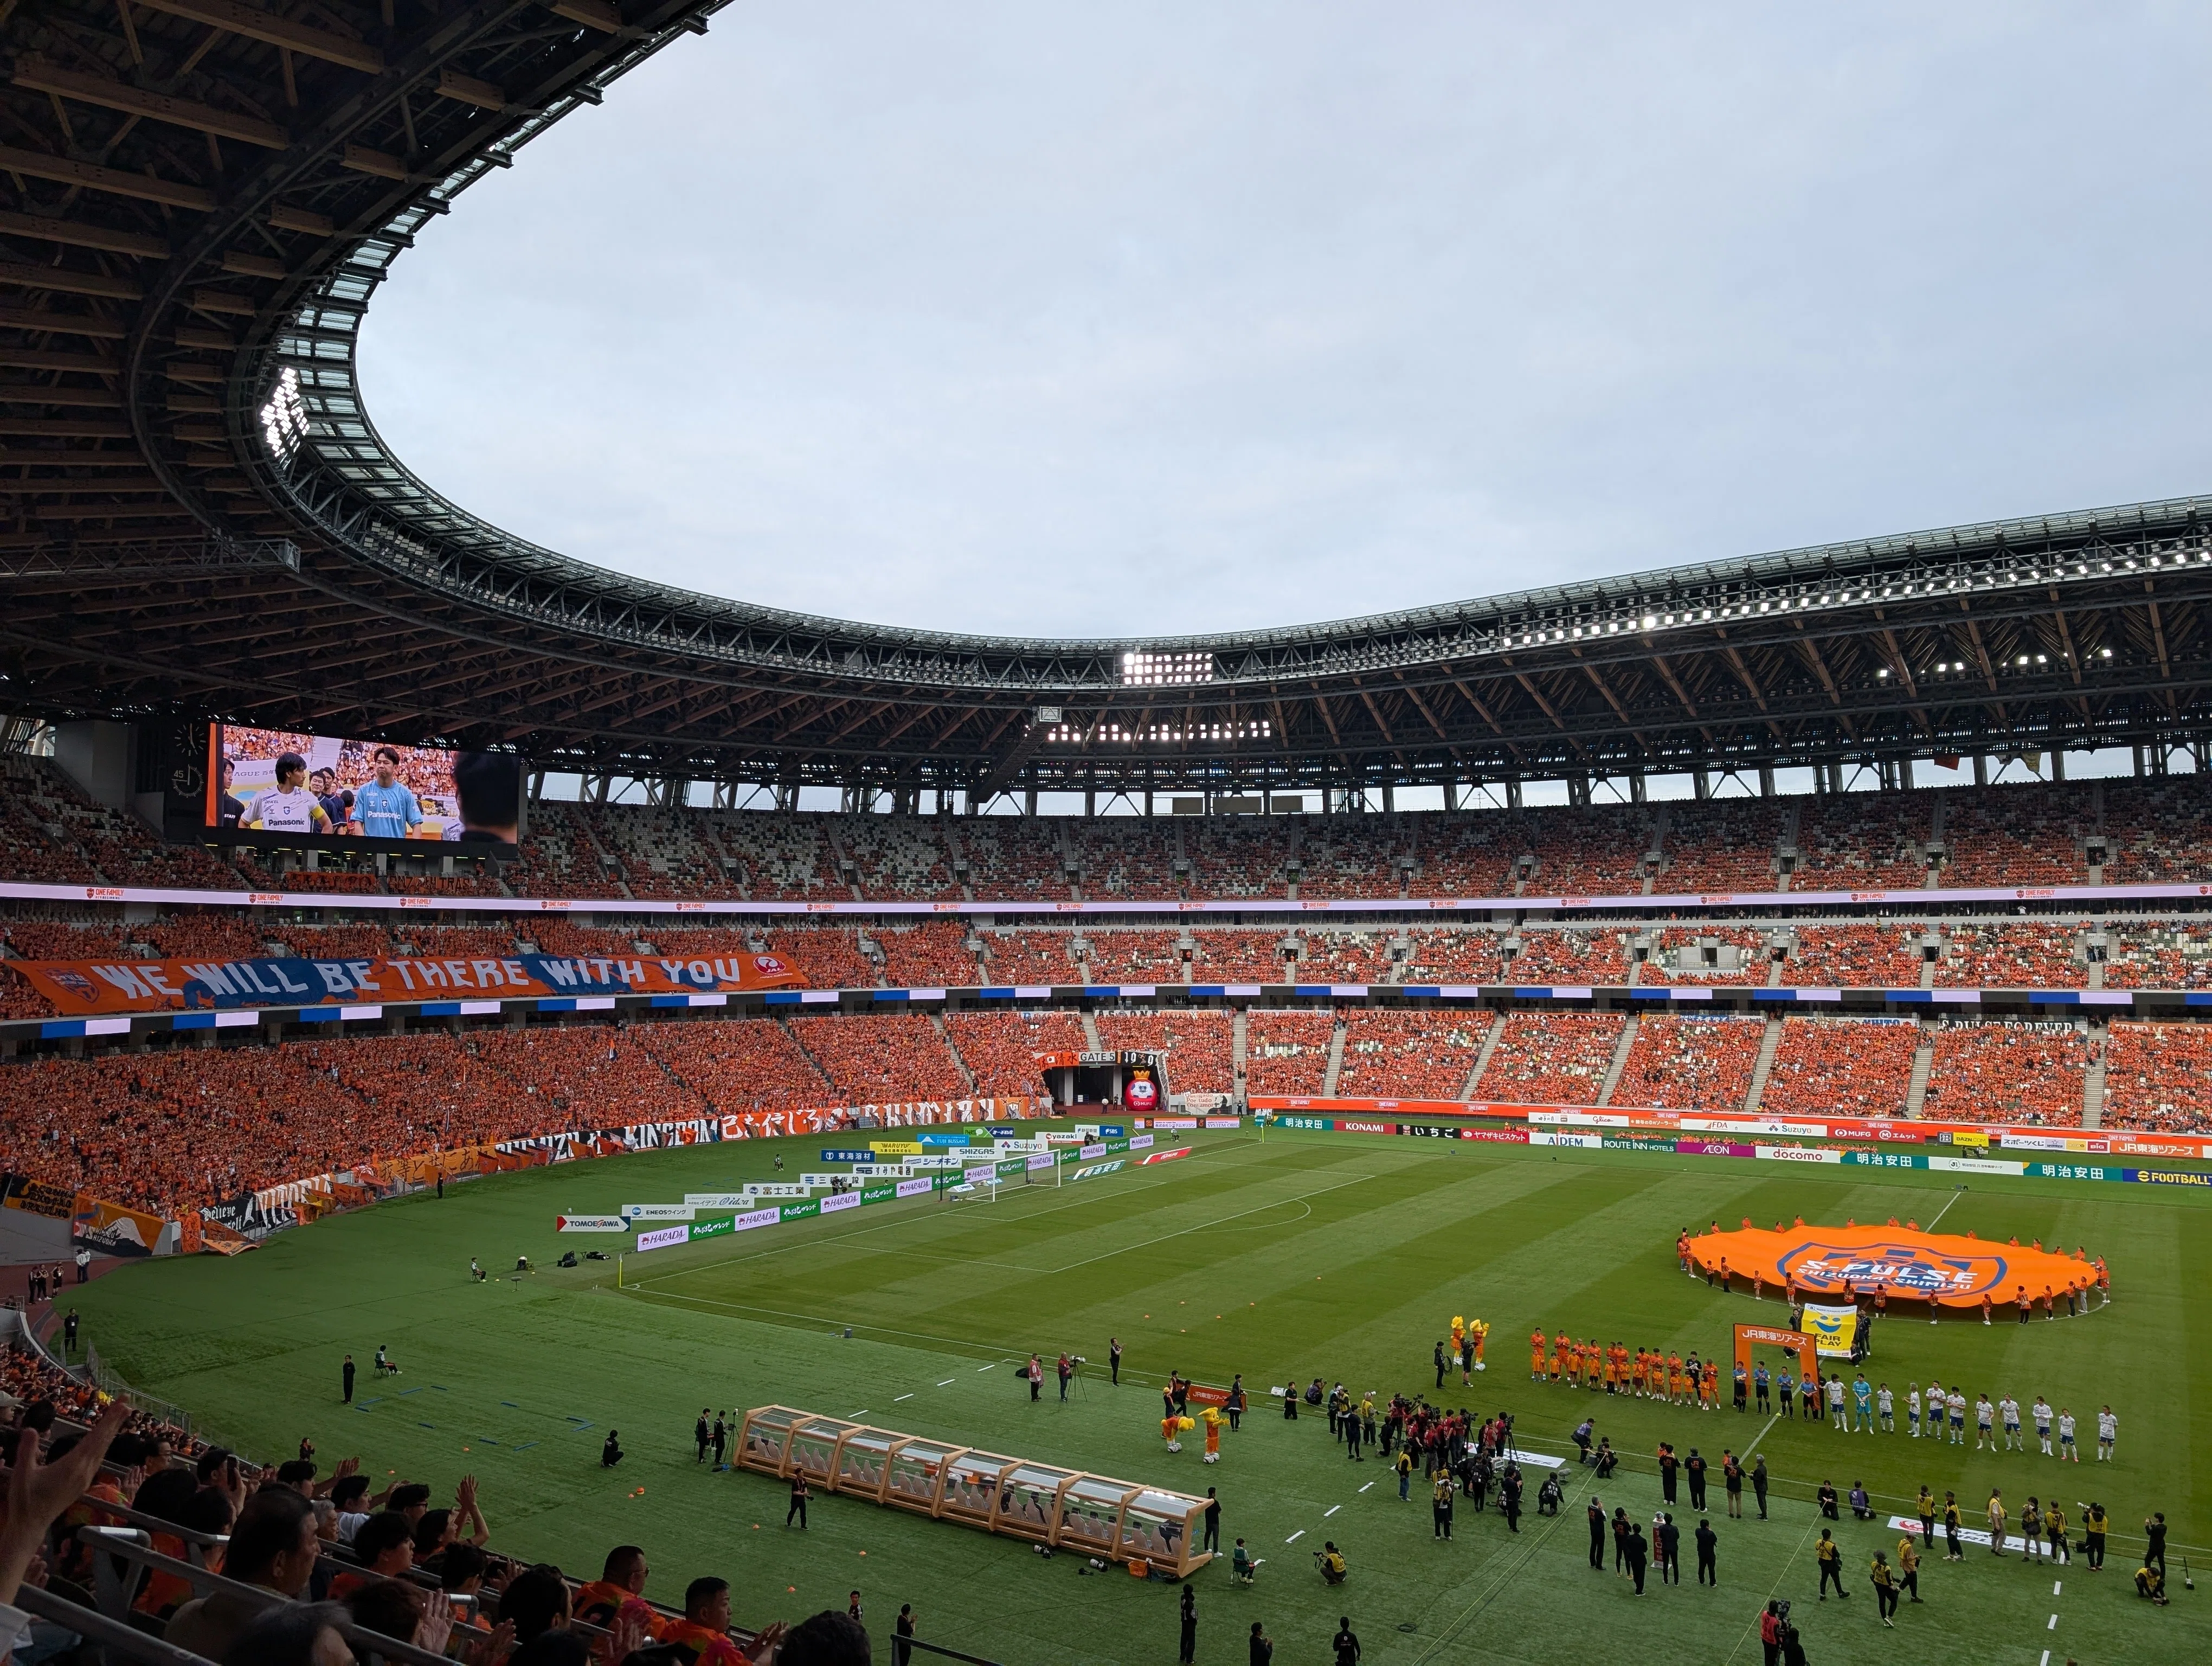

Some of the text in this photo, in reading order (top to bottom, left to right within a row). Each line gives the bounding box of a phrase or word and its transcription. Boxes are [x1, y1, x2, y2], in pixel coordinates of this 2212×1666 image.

[368, 811, 401, 819] Panasonic
[91, 958, 740, 999] WE WILL BE THERE WITH YOU
[1081, 1053, 1115, 1061] GATE 5
[1285, 1118, 1323, 1129] 明治安田
[1592, 1116, 1613, 1124] Glico
[1346, 1123, 1384, 1132] KONAMI
[1415, 1126, 1454, 1138] いちご
[1782, 1125, 1812, 1134] Suzuyo
[1135, 1137, 1152, 1145] HARADA
[1474, 1131, 1526, 1142] ヤマザキビスケット
[1013, 1140, 1042, 1150] Suzuyo
[1604, 1140, 1631, 1149] ROUTE
[2003, 1138, 2044, 1147] スポーツくじ
[1086, 1146, 1104, 1155] HARADA
[2119, 1142, 2195, 1156] JR東海ツアーズ
[838, 1152, 871, 1161] 東海溶材
[1773, 1149, 1823, 1161] docomo
[1032, 1156, 1052, 1166] HARADA
[1857, 1154, 1912, 1167] 明治安田
[875, 1165, 911, 1175] すみや電器
[972, 1168, 994, 1178] HARADA
[1084, 1162, 1121, 1177] 明治安田
[2043, 1165, 2104, 1180] 明治安田
[819, 1176, 859, 1185] 三仮設
[904, 1180, 930, 1190] HARADA
[763, 1186, 805, 1195] 富士工業
[830, 1195, 858, 1208] HARADA
[746, 1211, 777, 1225] HARADA
[569, 1220, 620, 1229] TOMOEGAWA
[650, 1229, 685, 1244] HARADA
[1801, 1259, 1978, 1284] S-PULSE
[1796, 1268, 1971, 1290] SHIZUOKA SHIMIZU
[1742, 1329, 1807, 1347] JR東海ツアーズ
[1815, 1332, 1841, 1342] FAIR
